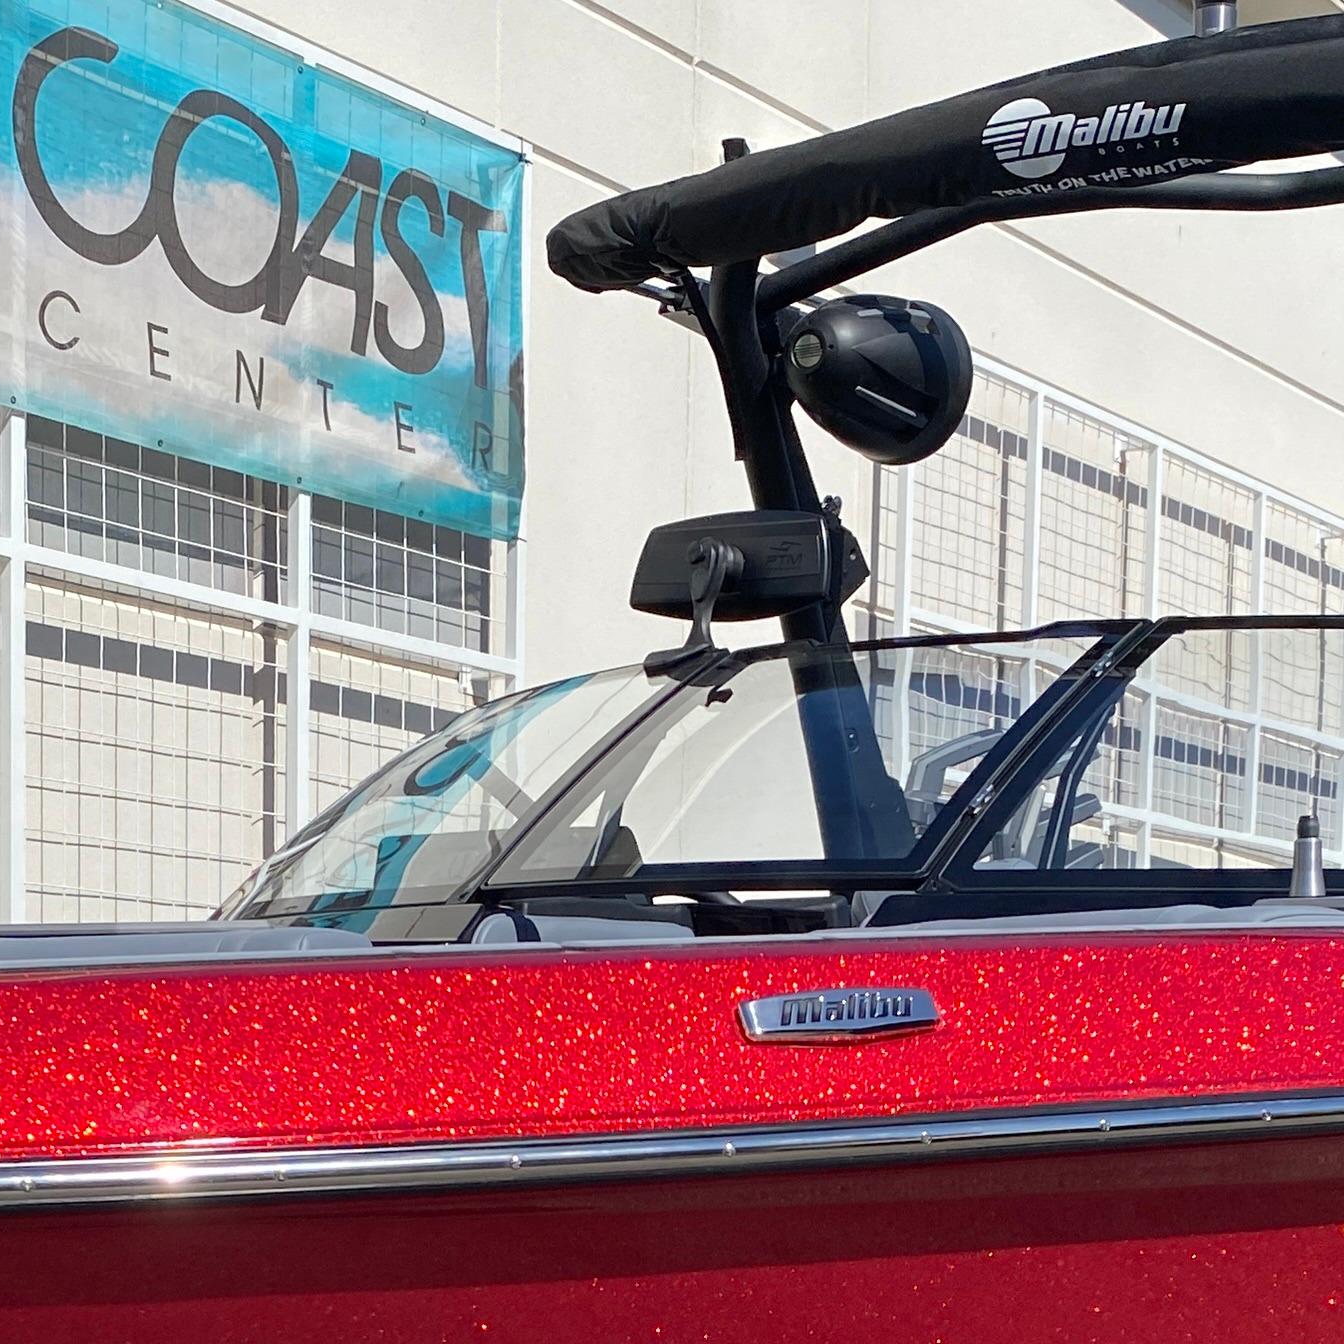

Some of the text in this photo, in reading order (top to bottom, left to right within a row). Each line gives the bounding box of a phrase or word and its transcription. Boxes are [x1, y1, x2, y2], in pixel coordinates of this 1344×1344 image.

[1057, 175, 1087, 191] ON
[1088, 166, 1132, 182] THE
[1097, 137, 1181, 156] BOATS
[12, 25, 508, 390] COAST
[37, 289, 494, 472] CENTER
